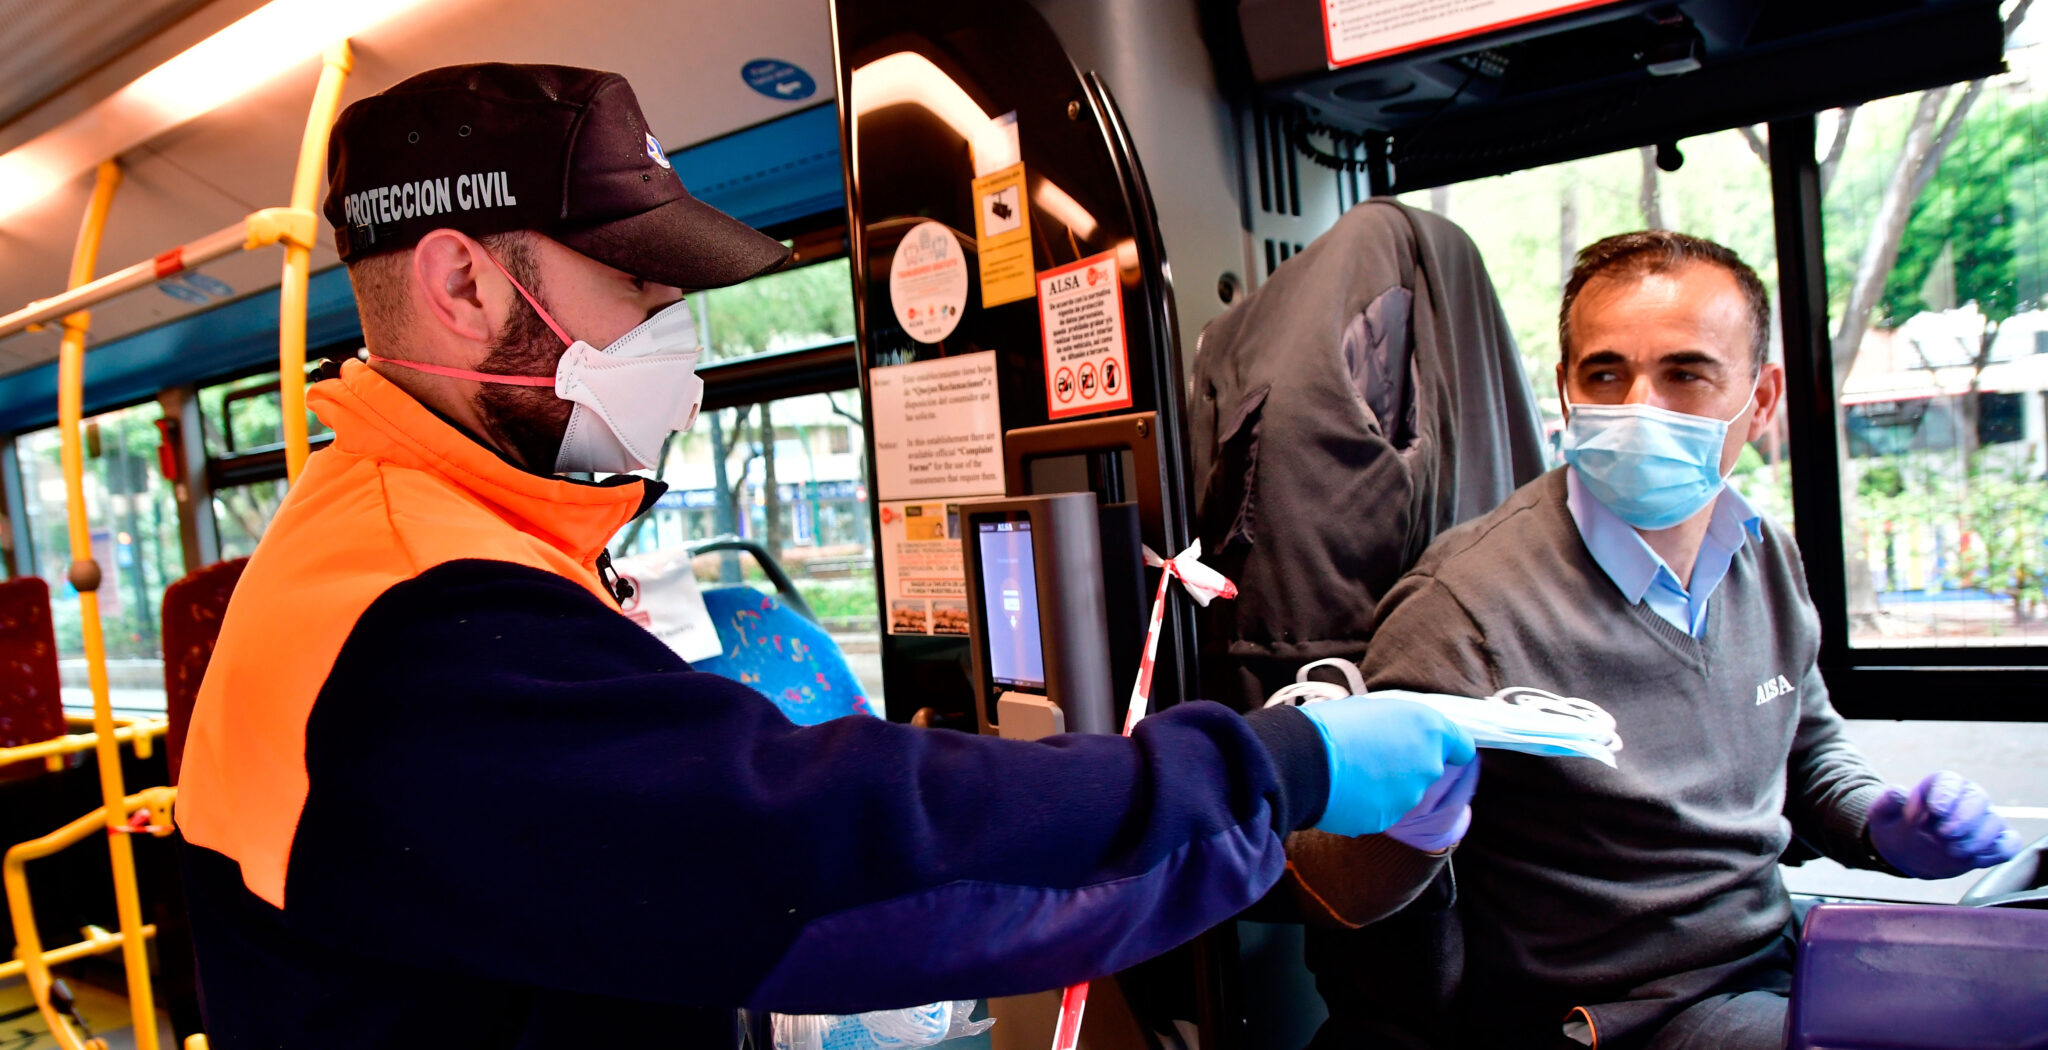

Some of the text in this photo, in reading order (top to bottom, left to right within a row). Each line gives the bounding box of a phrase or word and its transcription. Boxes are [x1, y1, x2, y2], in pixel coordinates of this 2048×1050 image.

[345, 172, 516, 225] PROTECCION CIVIL
[1049, 274, 1080, 295] ALSA
[944, 462, 953, 470] the
[1756, 674, 1796, 706] ALSA
